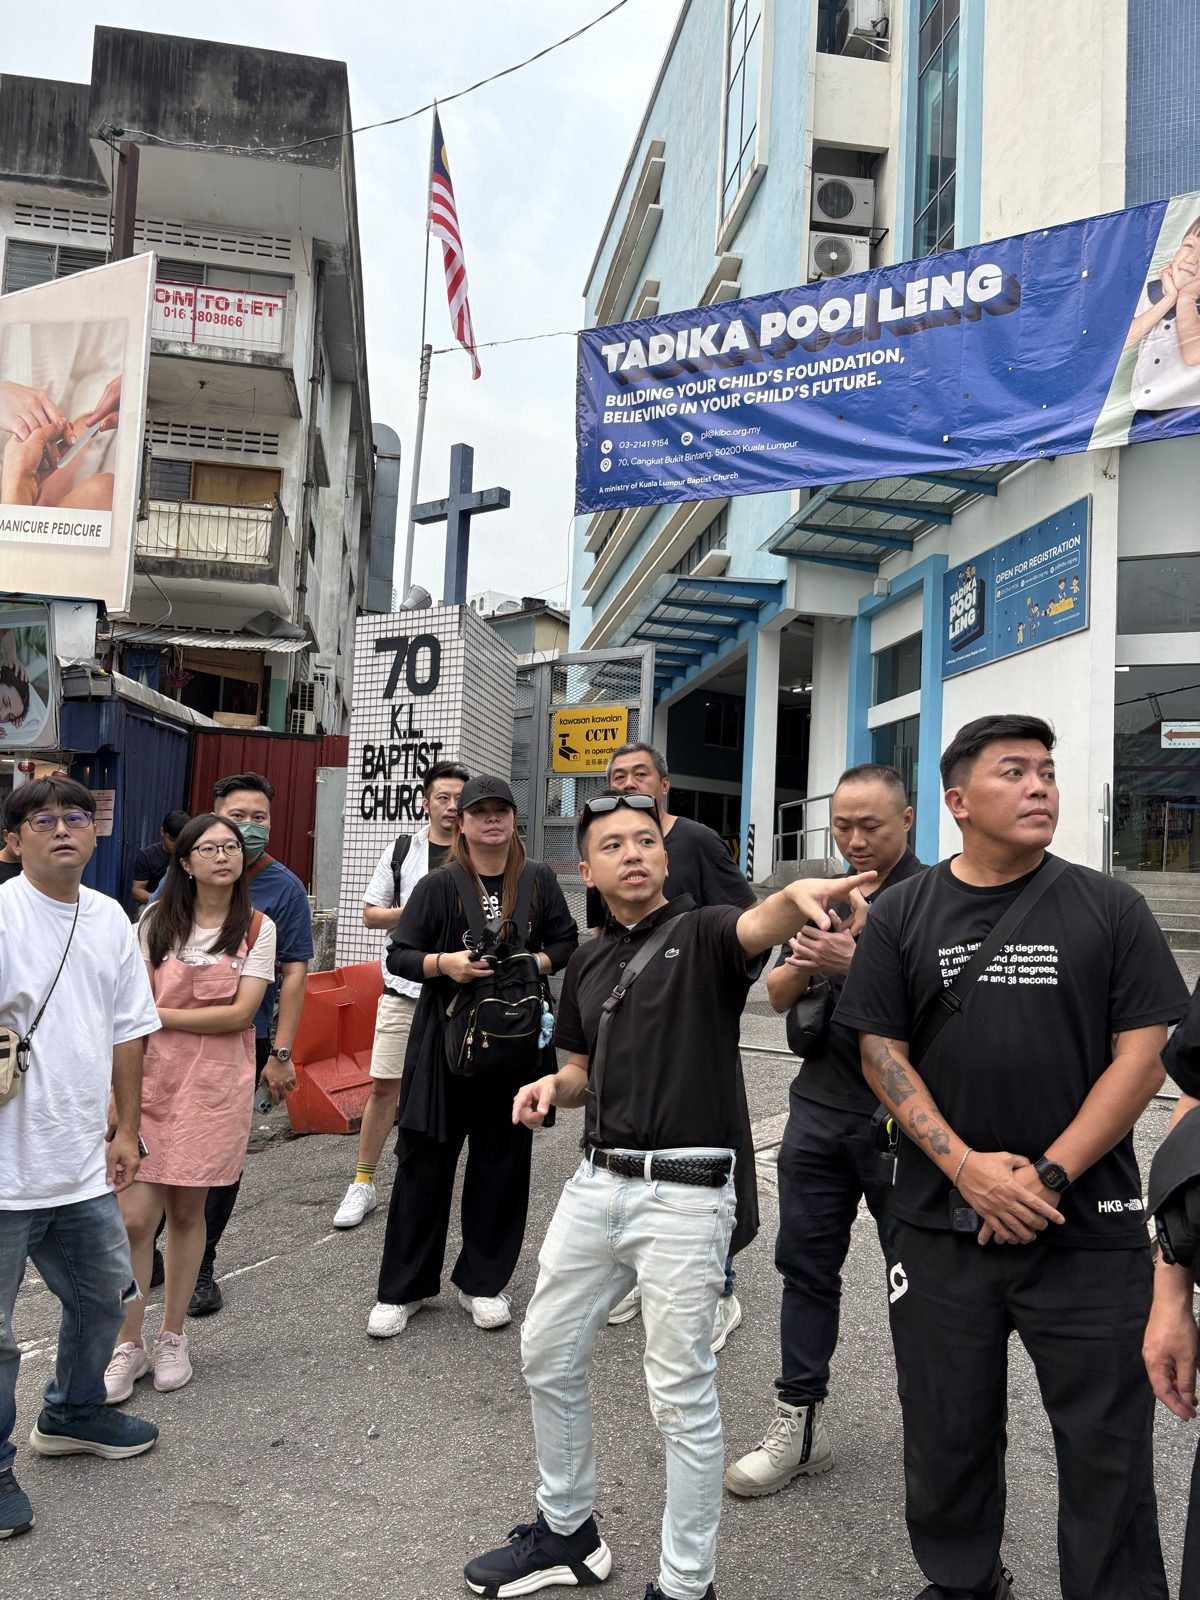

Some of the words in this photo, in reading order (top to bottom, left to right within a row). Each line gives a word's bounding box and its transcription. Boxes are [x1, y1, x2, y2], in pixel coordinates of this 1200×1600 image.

[154, 288, 194, 308] OM
[201, 293, 230, 311] TO
[236, 298, 278, 317] LET
[164, 306, 186, 319] 016
[602, 319, 749, 373] TADIKA
[760, 293, 867, 347] POOI
[878, 263, 1002, 323] LENG
[606, 388, 674, 407] BUILDING
[677, 378, 716, 398] YOUR
[719, 368, 783, 390] CHILD'S
[786, 348, 905, 382] FOUNDATION,
[603, 403, 678, 424] BELIEVING
[680, 401, 697, 414] IN
[700, 393, 740, 413] YOUR
[743, 382, 810, 405] CHILD'S
[812, 372, 882, 397] FUTURE.
[619, 440, 650, 449] 03-2141
[651, 438, 669, 447] 9154
[700, 426, 761, 441] pl@klbc.org.my
[617, 459, 629, 467] 70,
[630, 457, 663, 466] Cangkat
[665, 454, 683, 464] Bukit
[715, 445, 741, 456] 50200
[742, 444, 764, 452] Kuala
[766, 440, 798, 450] Lumpur
[604, 484, 629, 493] ministry
[639, 480, 657, 488] Kuala
[659, 479, 686, 487] Lumpur
[687, 476, 711, 484] Baptist
[712, 472, 738, 482] Church
[51, 522, 102, 537] PEDICURE
[995, 568, 1013, 584] OPEN
[1014, 561, 1028, 575] FOR
[1028, 534, 1081, 569] REGISTRATION
[950, 576, 977, 605] TADIKA
[949, 587, 977, 623] POOI
[948, 607, 976, 641] LENG
[375, 634, 441, 699] 70
[390, 703, 423, 739] K.L.
[559, 717, 590, 725] kawasan
[591, 715, 622, 723] kawalan
[585, 728, 618, 741] CCTV
[362, 742, 442, 780] BAPTIST
[591, 747, 617, 756] operatio
[360, 784, 429, 821] CHURC
[938, 944, 965, 957] North
[1004, 944, 1014, 954] 36
[1015, 943, 1058, 953] degrees,
[939, 957, 950, 967] 41
[990, 975, 1006, 983] and
[1007, 976, 1017, 985] 38
[1018, 976, 1058, 985] seconds
[1018, 965, 1058, 975] degrees,
[1098, 1200, 1123, 1213] HKB
